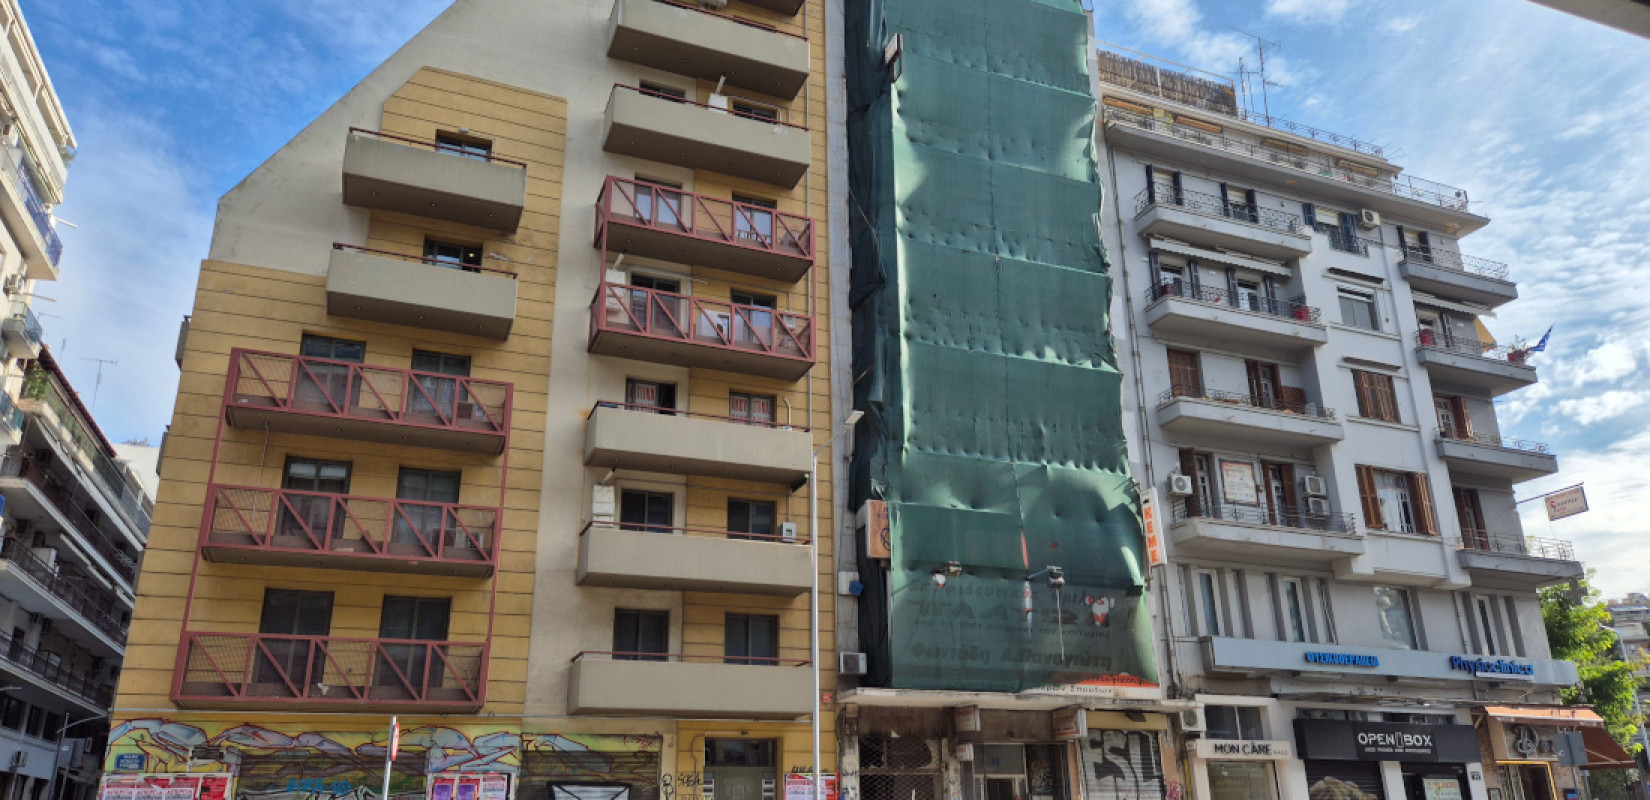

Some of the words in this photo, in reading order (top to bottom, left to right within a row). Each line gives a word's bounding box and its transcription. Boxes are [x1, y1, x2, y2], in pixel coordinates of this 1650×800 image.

[1357, 732, 1395, 746] OPEN
[1403, 733, 1433, 747] BOX
[1214, 743, 1240, 754] MON
